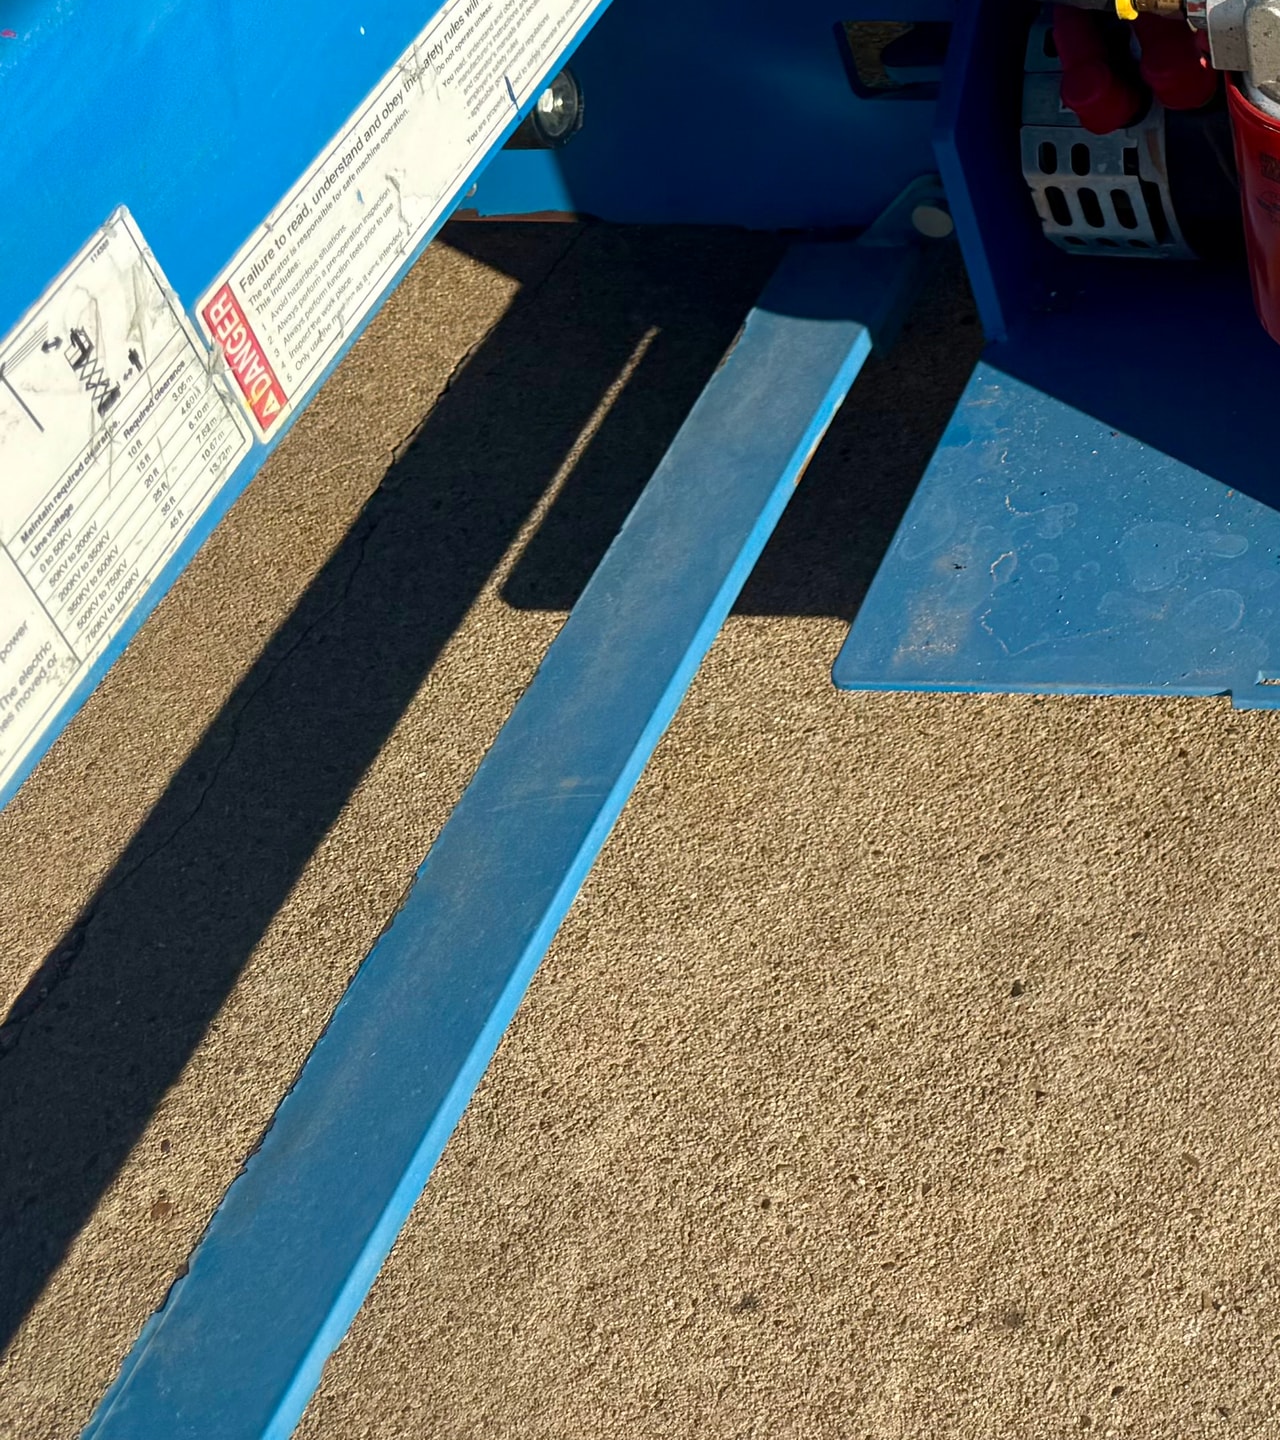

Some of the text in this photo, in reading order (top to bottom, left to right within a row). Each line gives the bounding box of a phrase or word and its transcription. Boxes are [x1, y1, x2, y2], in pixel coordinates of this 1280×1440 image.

[436, 62, 445, 75] Do
[445, 49, 454, 63] not
[455, 25, 474, 52] operate
[442, 10, 503, 88] You understand and
[239, 247, 275, 293] Failure
[275, 233, 286, 250] to
[286, 202, 312, 237] read,
[311, 136, 363, 205] understand
[363, 114, 381, 142] and
[381, 88, 404, 120] obey
[443, 15, 464, 43] rules
[466, 129, 478, 145] You
[248, 107, 409, 306] The operator is responsible for safe machine operation.
[255, 259, 301, 315] This includes:
[270, 295, 288, 322] Avoid
[287, 258, 319, 299] hazardous
[277, 304, 299, 334] Always
[298, 275, 322, 308] perform
[325, 222, 363, 273] pre-operation
[283, 316, 305, 347] Always
[304, 287, 328, 321] perform
[327, 258, 350, 289] function
[349, 240, 364, 261] tests
[363, 223, 376, 245] prior
[376, 216, 383, 225] to
[289, 327, 311, 360] Inspect
[310, 315, 321, 330] the
[321, 297, 335, 317] work
[335, 275, 353, 300] place.
[207, 290, 272, 405] DANGER
[295, 351, 310, 371] Only
[21, 419, 120, 544] Maintain required clearance.
[30, 359, 185, 559] Line voltage Required clearance
[45, 554, 54, 566] to
[53, 528, 72, 556] 50KV
[128, 445, 137, 459] 10
[136, 438, 142, 448] ft
[172, 381, 187, 402] 3.05
[58, 409, 202, 603] 200KV to 350KV 20 ft 6.10
[49, 559, 68, 588] 50KV
[68, 551, 76, 563] to
[75, 520, 97, 554] 200KV
[136, 459, 145, 473] 15
[144, 452, 151, 463] ft
[67, 481, 169, 616] 350KV to 500KV 25 ft
[77, 596, 99, 631] 500KV
[99, 589, 107, 601] to
[105, 558, 127, 591] 750KV
[161, 501, 170, 516] 35
[169, 495, 175, 505] ft
[85, 610, 108, 644] 750KV
[107, 603, 115, 615] to
[170, 515, 179, 530] 45
[178, 509, 184, 519] ft
[0, 619, 28, 664] power
[14, 652, 57, 713] moved or
[18, 639, 52, 687] electric
